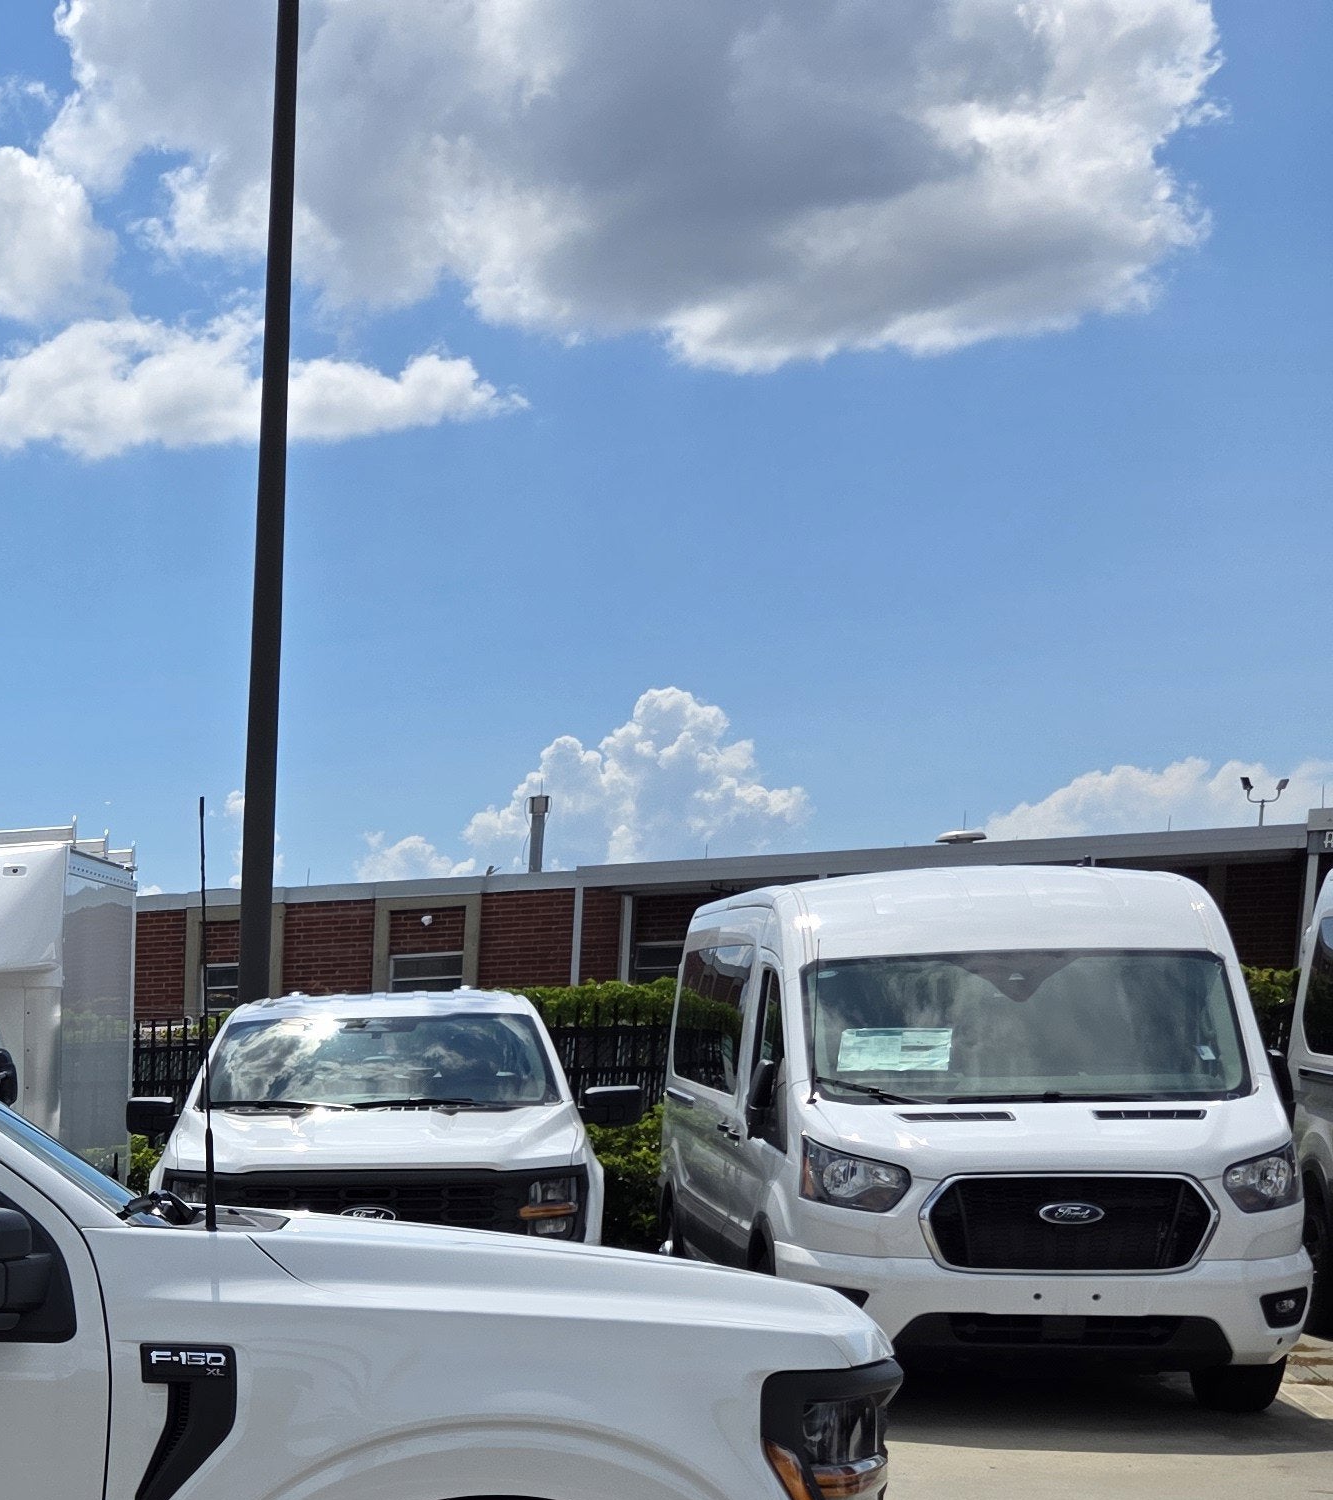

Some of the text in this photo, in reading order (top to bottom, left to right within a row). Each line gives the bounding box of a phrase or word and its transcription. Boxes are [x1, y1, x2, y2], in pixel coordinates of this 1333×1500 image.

[1054, 1206, 1091, 1219] Ford
[150, 1350, 227, 1366] F-150
[205, 1367, 225, 1376] XL
